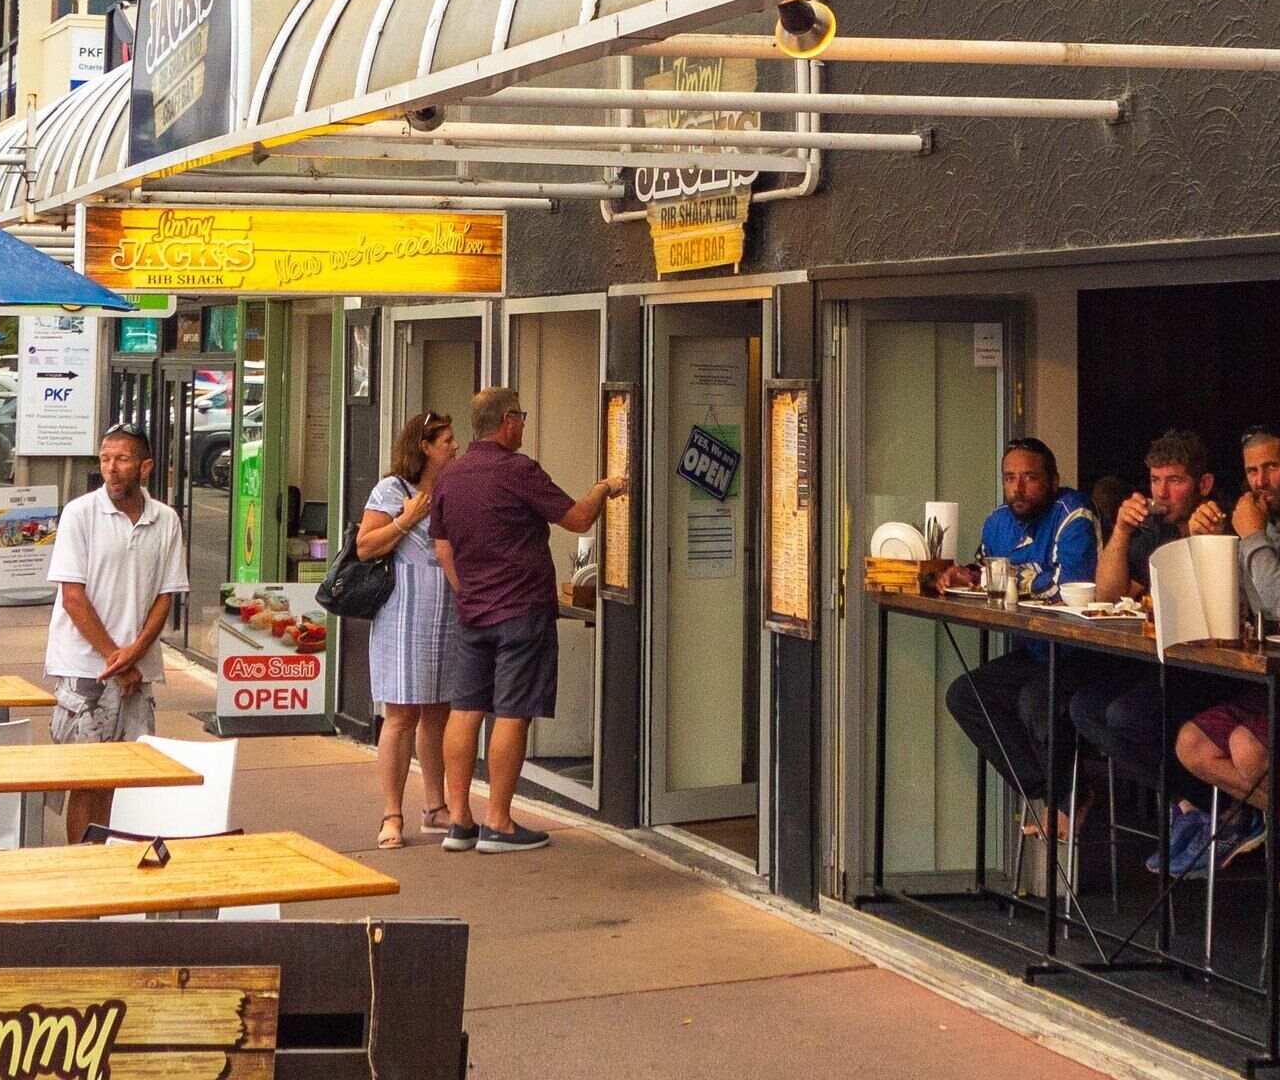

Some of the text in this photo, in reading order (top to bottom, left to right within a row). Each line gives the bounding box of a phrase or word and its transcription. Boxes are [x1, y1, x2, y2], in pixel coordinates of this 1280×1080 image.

[79, 47, 104, 58] PKF
[660, 195, 739, 231] RIB SHACK AND
[110, 238, 256, 272] JACK'S
[154, 209, 215, 245] Jimmy
[273, 251, 323, 287] Now
[330, 233, 387, 267] we're
[669, 235, 726, 267] CRAFT BAR
[147, 274, 225, 286] RIB SHACK
[44, 388, 74, 402] PKF
[683, 447, 731, 492] OPEN
[228, 657, 315, 678] Avo Sushi
[234, 688, 308, 711] OPEN
